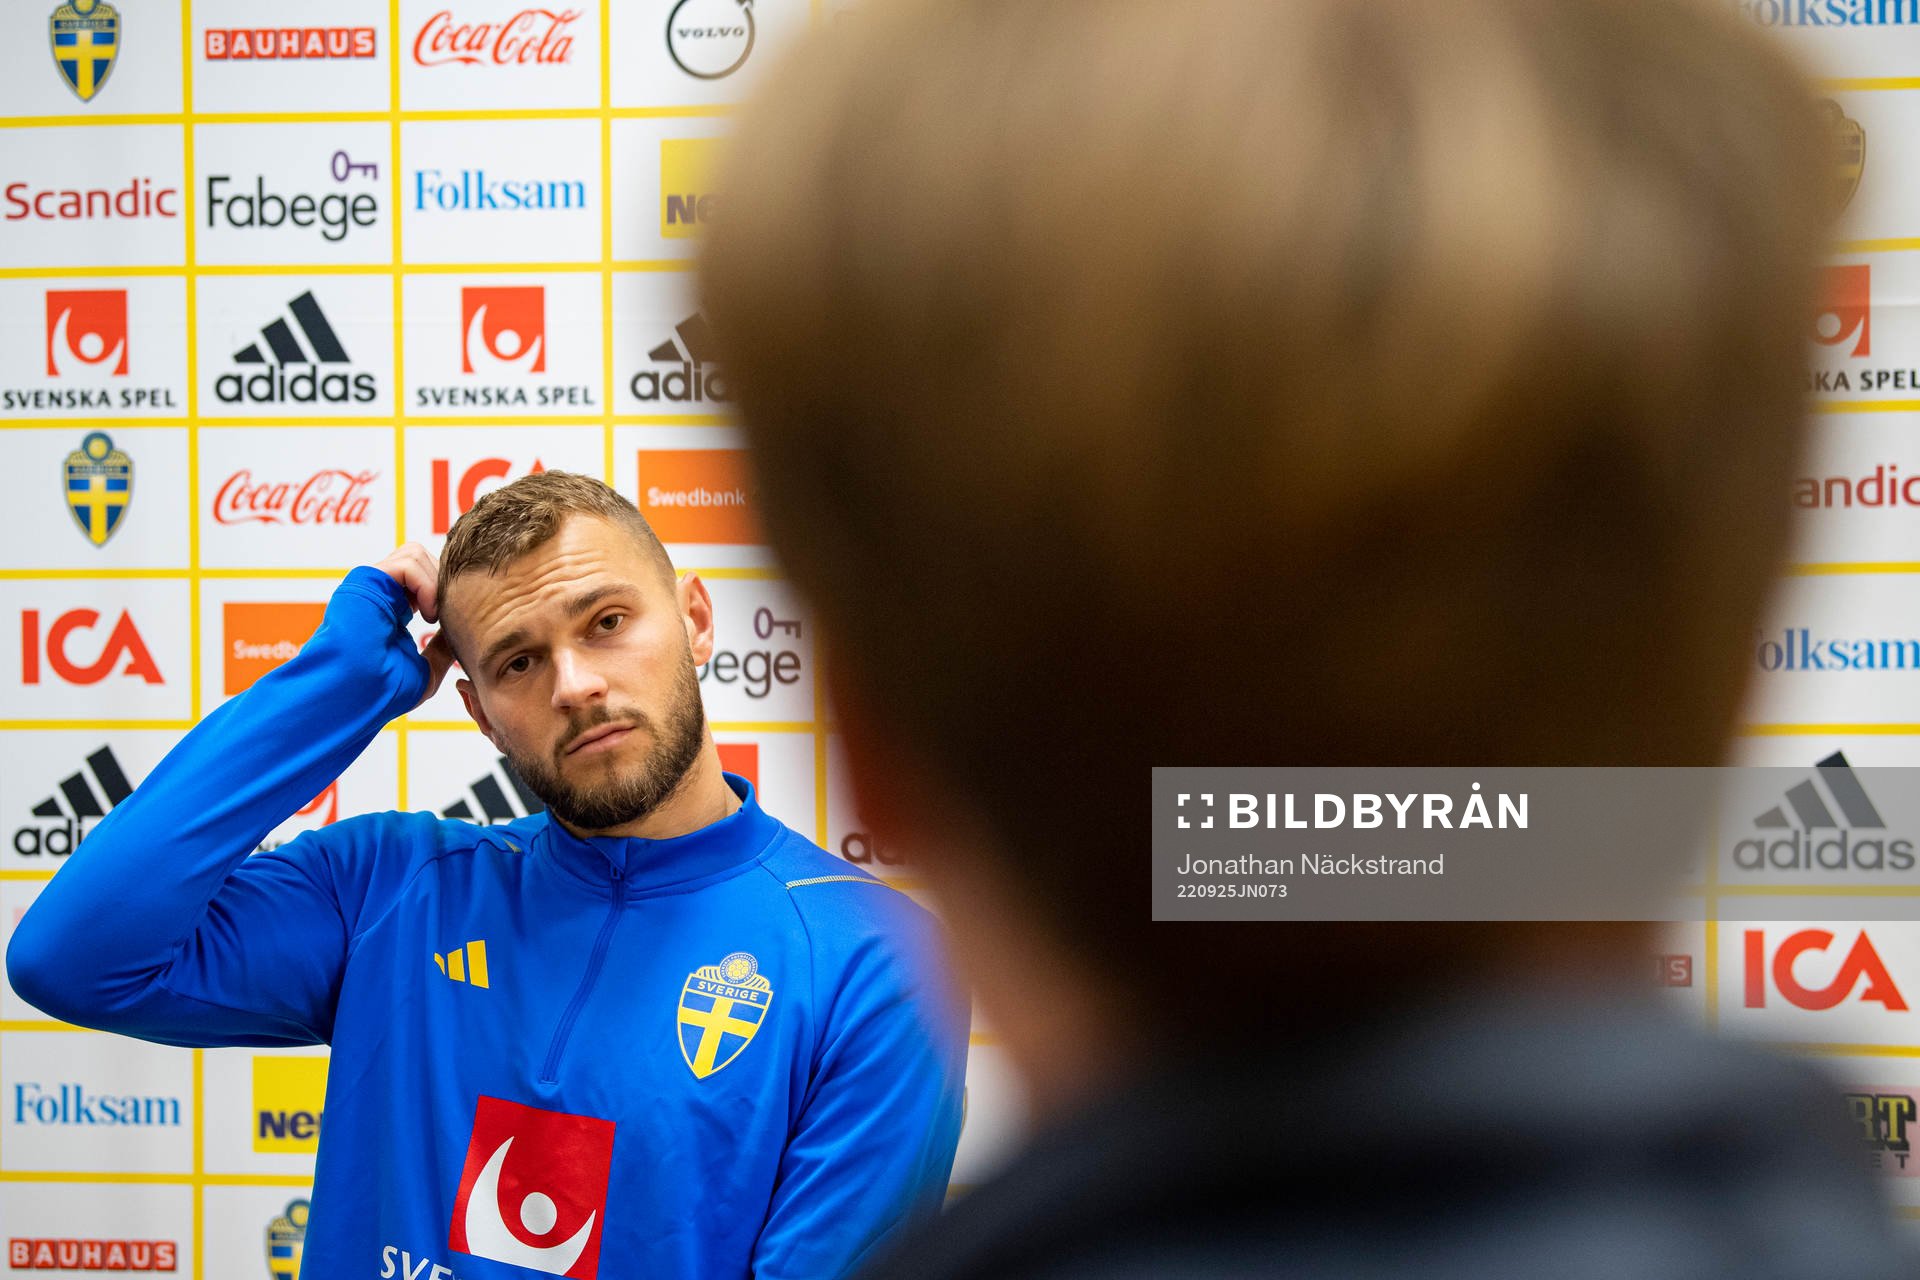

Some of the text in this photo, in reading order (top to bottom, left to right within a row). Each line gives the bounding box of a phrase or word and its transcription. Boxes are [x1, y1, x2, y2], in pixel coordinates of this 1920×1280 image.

[1748, 0, 1920, 26] olksam
[206, 29, 375, 60] BAUHAUS
[677, 26, 745, 39] VOLVO
[5, 178, 177, 220] Scandic
[414, 169, 587, 211] Folksam
[207, 176, 378, 242] Fabege
[215, 364, 377, 404] adidas
[1860, 369, 1920, 391] SPEL
[3, 389, 177, 410] SVENSKA SPEL
[417, 386, 594, 406] SVENSKA SPEL
[647, 487, 746, 507] Swedbank
[21, 608, 165, 687] ICA
[234, 639, 302, 659] Swedb
[1757, 628, 1920, 671] olksam
[1733, 829, 1915, 870] adidas
[1744, 929, 1909, 1011] ICA
[697, 981, 759, 1001] SVERIGE
[14, 1082, 181, 1125] Folksam
[259, 1110, 323, 1139] Ne
[9, 1239, 177, 1271] BAUHAUS
